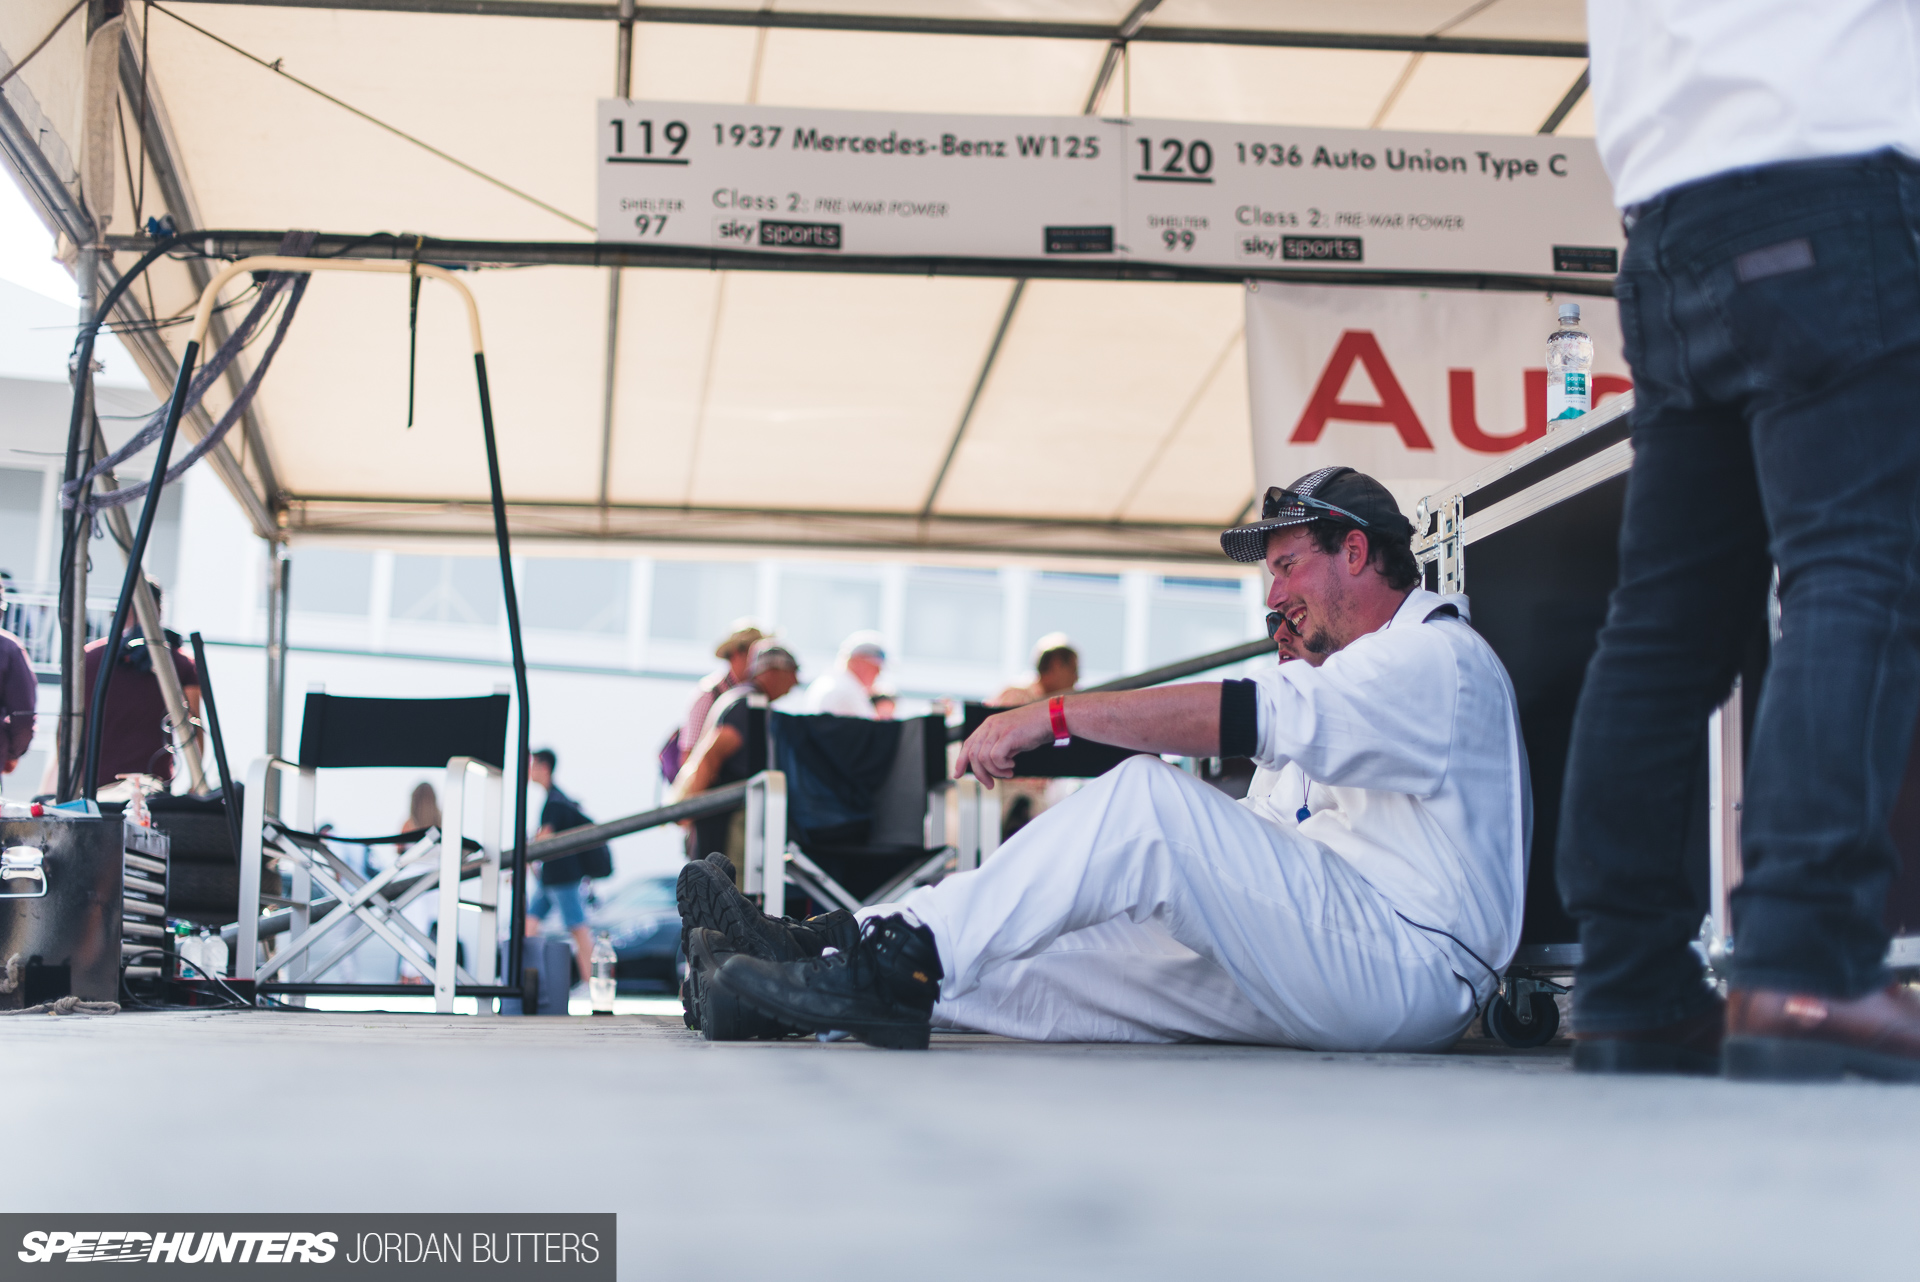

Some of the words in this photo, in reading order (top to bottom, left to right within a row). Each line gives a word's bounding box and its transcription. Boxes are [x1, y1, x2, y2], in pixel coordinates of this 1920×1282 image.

[609, 118, 690, 156] 119
[713, 123, 783, 148] 1937
[792, 127, 1007, 157] Mercedes-Benz
[1017, 134, 1101, 159] W125
[1137, 137, 1214, 175] 120
[1235, 142, 1304, 167] 1936
[1311, 145, 1377, 170] Auto
[1385, 148, 1468, 173] Union
[1475, 151, 1540, 181] Type
[1548, 153, 1568, 177] C
[619, 197, 685, 212] SHELTER
[711, 188, 778, 209] Class
[787, 192, 809, 213] 2:
[813, 196, 884, 216] PRE-WAR
[889, 198, 949, 218] POWER
[634, 214, 668, 236] 97
[1147, 215, 1210, 230] SHELTER
[1234, 205, 1299, 227] Class
[1306, 208, 1330, 228] 2:
[1334, 211, 1404, 230] PRE-WAR
[1406, 213, 1466, 232] POWER
[718, 220, 754, 242] sky
[762, 223, 840, 246] sports
[1162, 229, 1197, 251] 99
[1242, 235, 1277, 259] sky
[1283, 238, 1360, 259] sports
